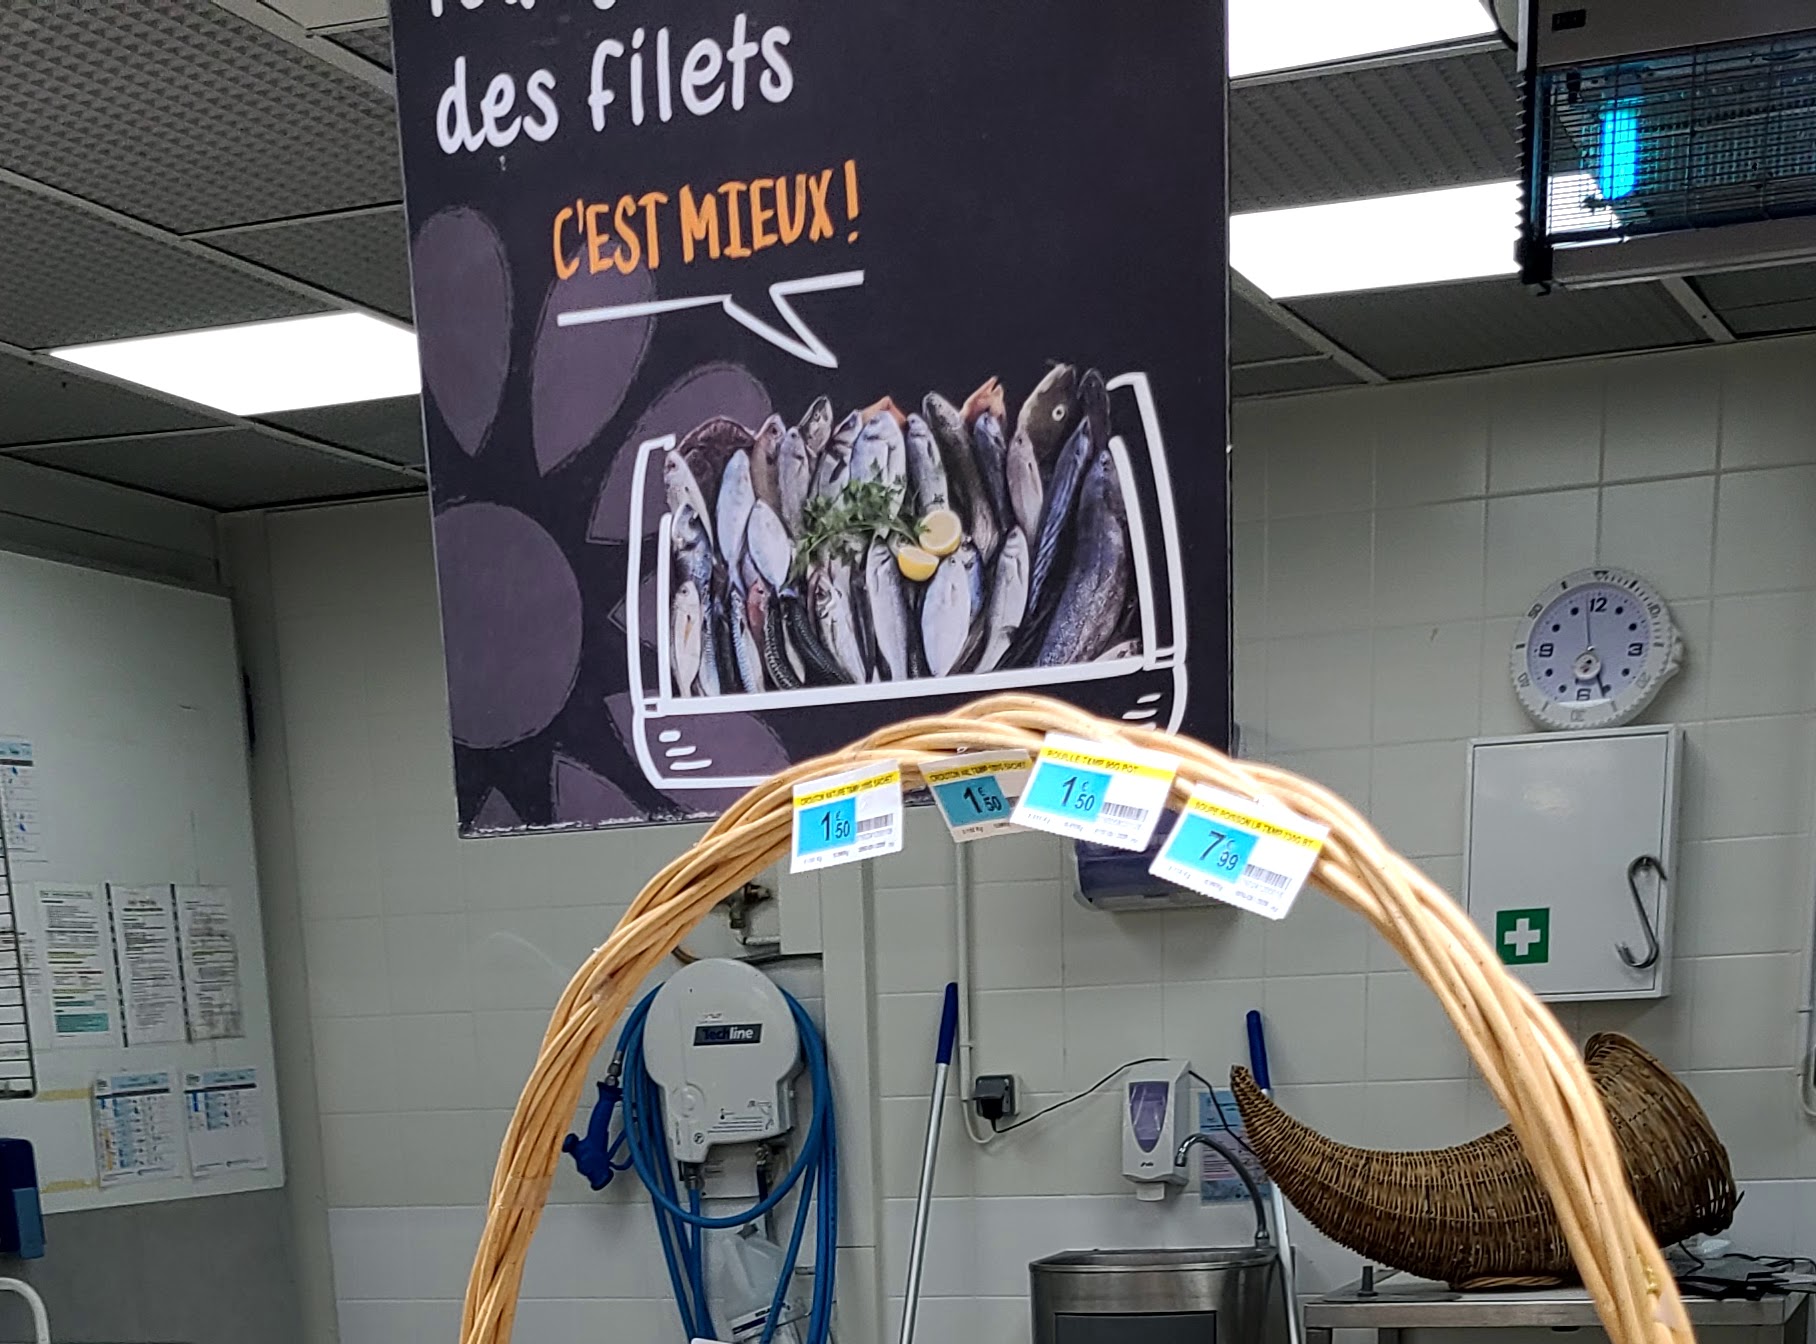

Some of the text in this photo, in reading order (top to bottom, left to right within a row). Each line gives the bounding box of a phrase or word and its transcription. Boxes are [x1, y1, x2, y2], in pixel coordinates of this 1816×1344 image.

[436, 13, 794, 154] des filets
[553, 191, 668, 279] C'EST
[680, 169, 833, 264] MIEUX
[1590, 597, 1608, 613] 12
[1538, 642, 1554, 658] 9
[1627, 642, 1643, 656] 3
[963, 787, 982, 813] 1
[984, 797, 1002, 812] 50
[1062, 776, 1077, 807] 1
[1075, 794, 1095, 811] 50
[821, 811, 830, 841] 1
[835, 821, 850, 839] 50
[1200, 830, 1227, 861] 7
[1217, 851, 1239, 871] 99
